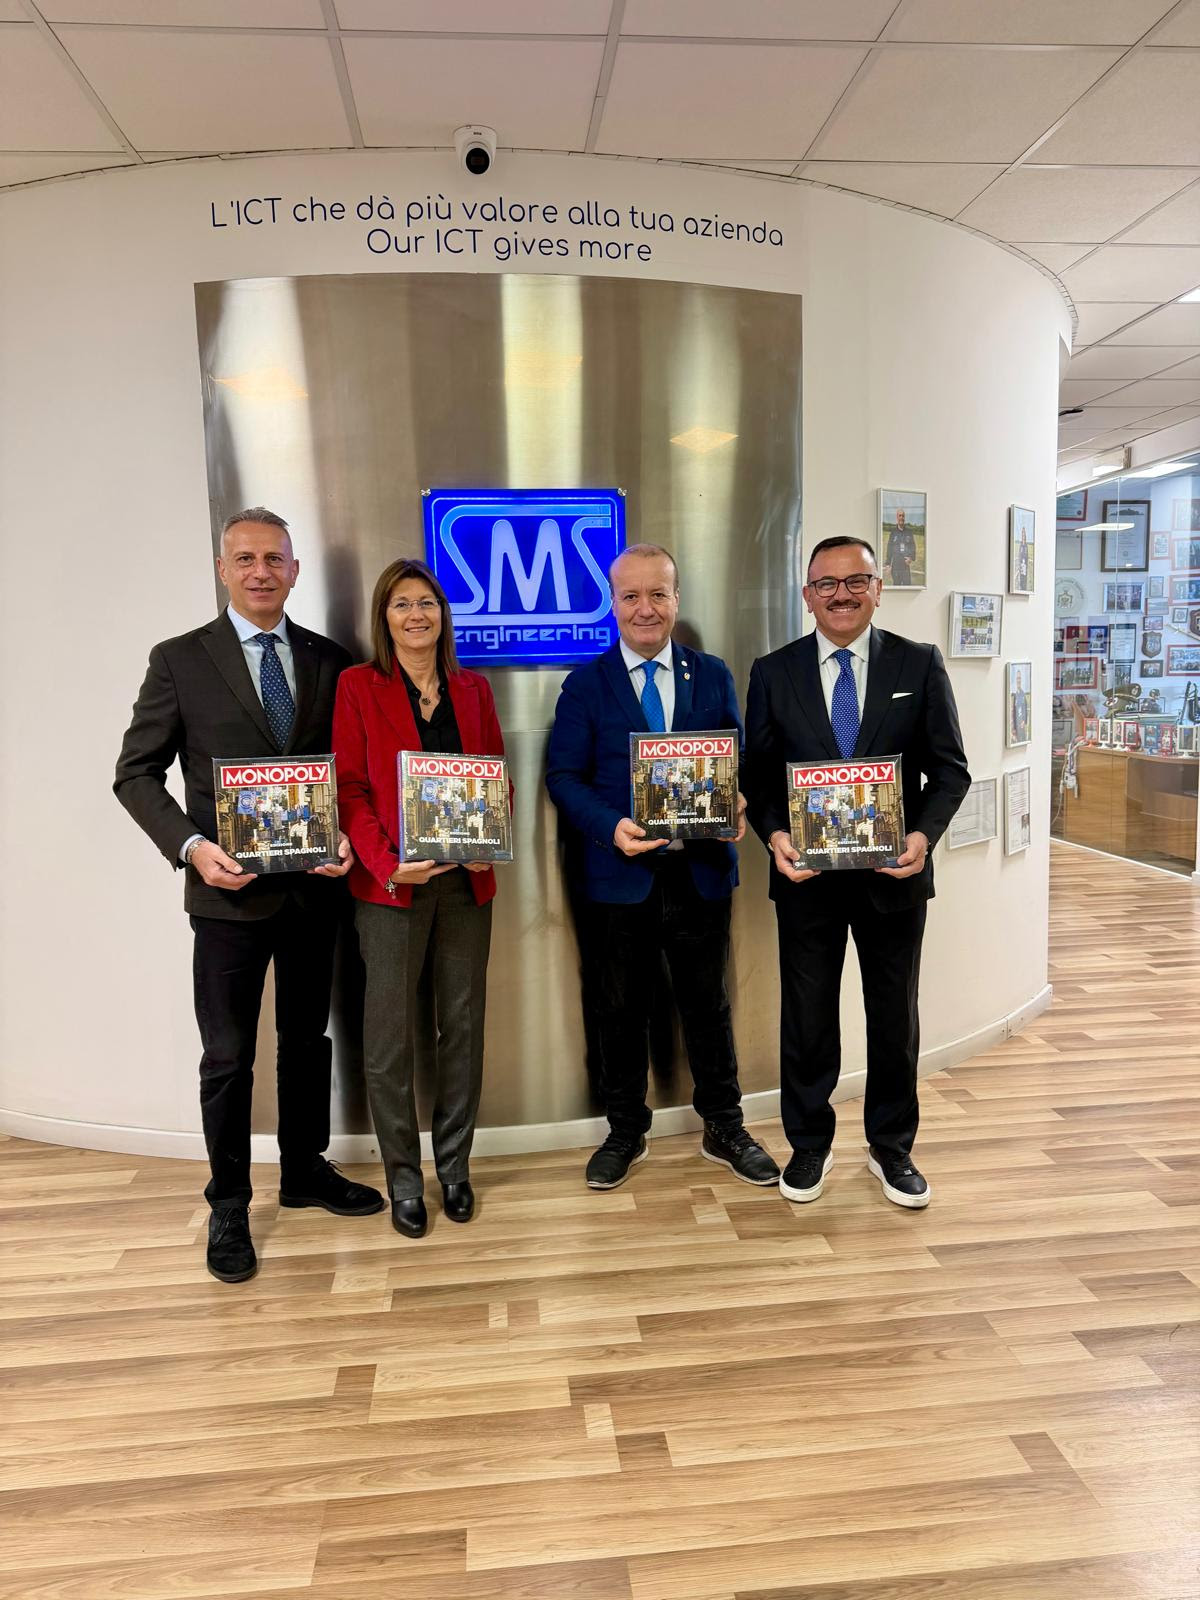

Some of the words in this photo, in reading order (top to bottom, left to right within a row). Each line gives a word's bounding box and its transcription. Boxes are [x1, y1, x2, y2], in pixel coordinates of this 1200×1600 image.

[211, 197, 282, 227] L'ICT
[293, 196, 346, 222] che
[356, 195, 395, 220] dà
[406, 193, 451, 228] più
[462, 196, 558, 223] valore
[568, 200, 620, 228] alla
[629, 205, 675, 233] tua
[683, 214, 784, 247] azienda
[367, 228, 425, 254] Our
[435, 228, 484, 254] ICT
[493, 231, 569, 261] gives
[579, 239, 652, 261] more
[439, 504, 614, 627] SMS
[642, 741, 731, 757] MONOPOLY
[225, 766, 327, 784] MONOPOLY
[411, 759, 500, 777] MONOPOLY
[797, 765, 891, 785] MONOPOLY
[689, 816, 727, 825] SPAGNOLI
[418, 836, 461, 844] QUARTIERI
[462, 837, 501, 845] SPAGNOLI
[235, 850, 283, 858] QUARTIERI
[284, 846, 327, 856] SPAGNOLI
[806, 846, 850, 855] QUARTIERI
[850, 845, 893, 853] SPAGNOLI
